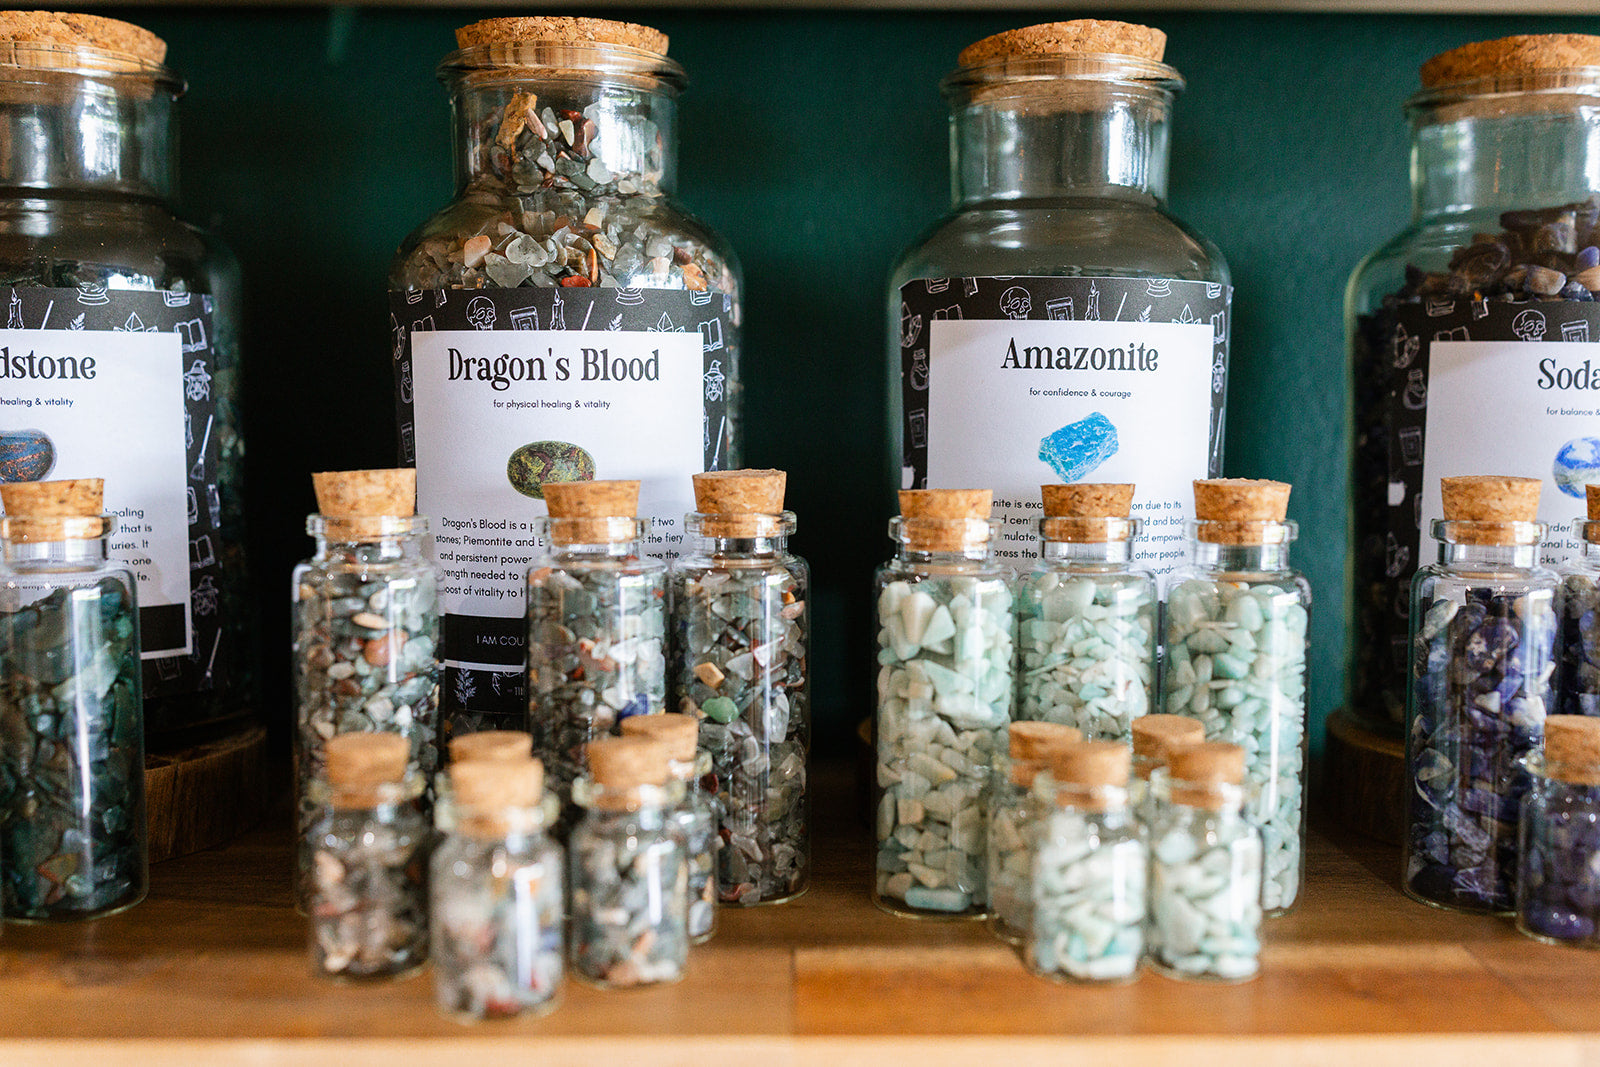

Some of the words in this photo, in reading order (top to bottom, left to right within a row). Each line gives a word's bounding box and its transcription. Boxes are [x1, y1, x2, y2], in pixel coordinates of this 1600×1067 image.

[1000, 336, 1159, 372] Amazonite
[448, 347, 570, 392] Dragon's
[580, 348, 660, 381] Blood
[1029, 387, 1041, 396] for
[1043, 387, 1089, 397] confidence
[1091, 389, 1097, 397] &
[1099, 390, 1132, 399] courage
[35, 398, 42, 406] &
[44, 397, 74, 408] vitality
[493, 399, 505, 408] for
[506, 399, 540, 411] physical
[541, 399, 572, 411] healing
[574, 400, 582, 409] &
[583, 400, 611, 411] vitality
[1546, 406, 1558, 416] for
[1560, 408, 1593, 416] balance
[1014, 500, 1022, 508] is
[1146, 500, 1161, 510] due
[1164, 501, 1172, 510] to
[1174, 501, 1182, 509] its
[442, 517, 478, 530] Dragon's
[479, 519, 507, 530] Blood
[509, 521, 517, 530] is
[658, 518, 675, 527] two
[1153, 516, 1168, 525] and
[120, 524, 141, 533] that
[144, 524, 153, 533] is
[435, 534, 462, 545] stones;
[463, 535, 512, 547] Piemontite
[515, 536, 535, 547] and
[648, 533, 663, 544] the
[665, 532, 684, 544] fiery
[439, 551, 454, 561] and
[455, 553, 498, 564] persistent
[665, 549, 680, 560] the
[1022, 548, 1038, 559] the
[1135, 549, 1157, 560] other
[132, 558, 152, 566] one
[470, 570, 506, 580] needed
[508, 571, 519, 580] to
[463, 585, 472, 595] of
[474, 587, 505, 600] vitality
[507, 588, 517, 598] to
[482, 635, 498, 645] AM
